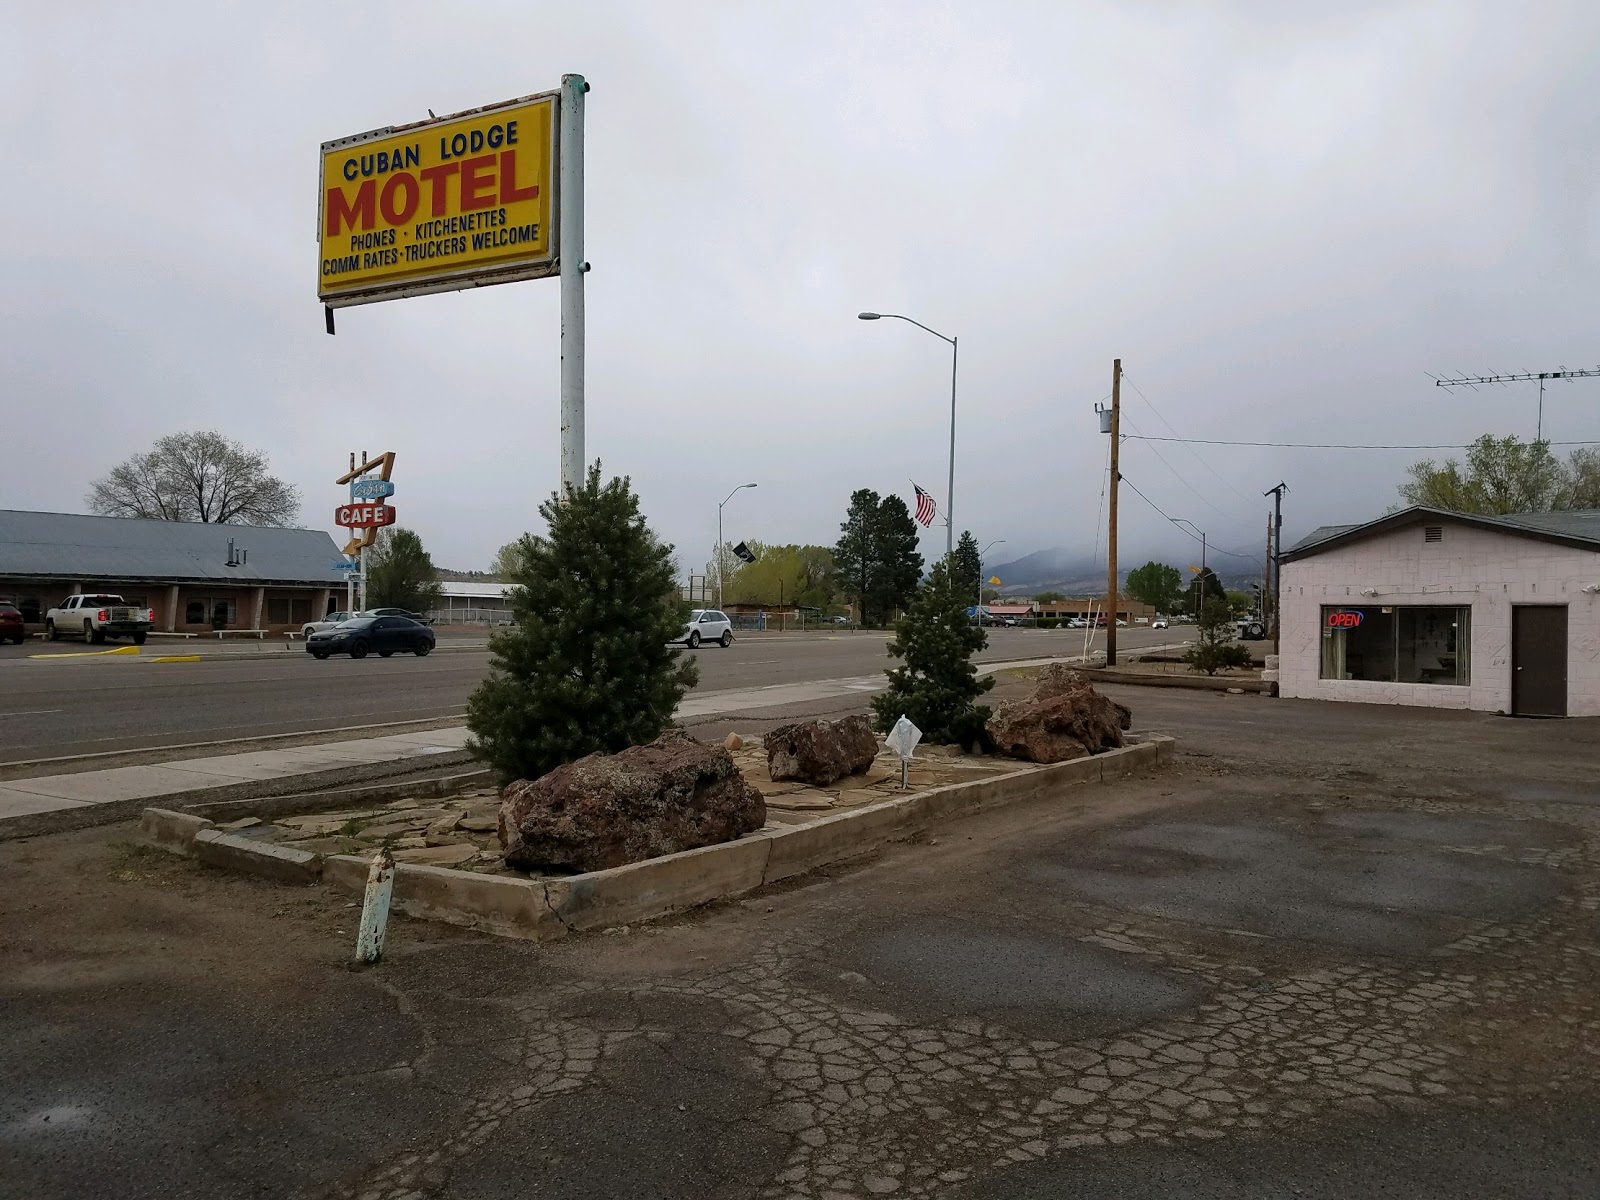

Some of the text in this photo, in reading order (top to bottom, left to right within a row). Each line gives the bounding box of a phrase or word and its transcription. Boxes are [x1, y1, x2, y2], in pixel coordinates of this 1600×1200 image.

[343, 120, 518, 181] CUBAN LODGE
[326, 149, 539, 238] MOTEL
[351, 208, 506, 252] PHONES KITCHENETTES
[363, 248, 398, 271] RATES
[404, 235, 467, 263] TRUCKERS
[472, 223, 539, 251] WELCOME
[341, 507, 384, 524] CAFE
[1328, 613, 1361, 626] OPEN
